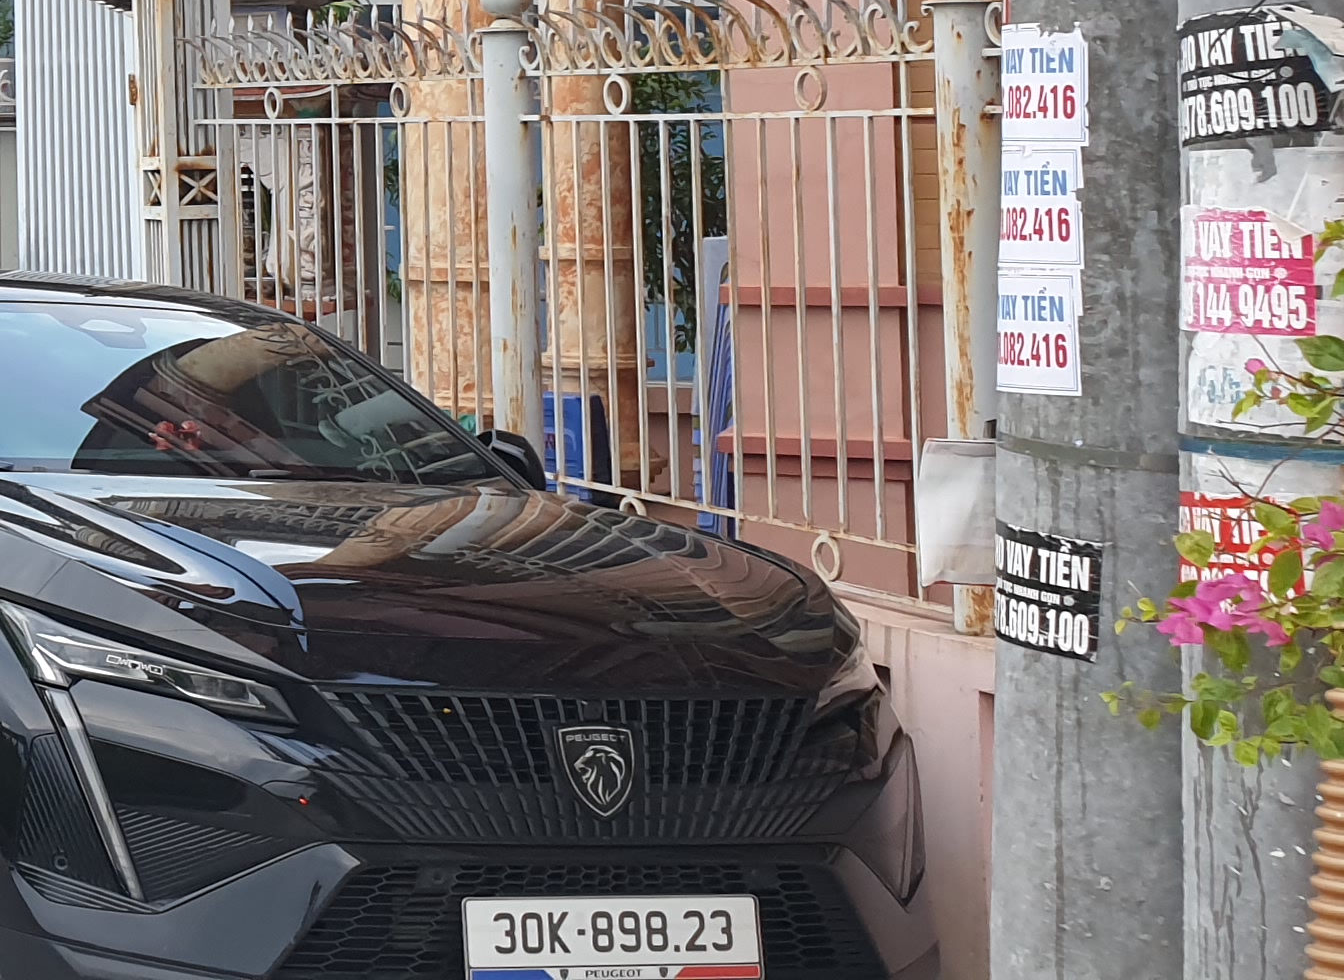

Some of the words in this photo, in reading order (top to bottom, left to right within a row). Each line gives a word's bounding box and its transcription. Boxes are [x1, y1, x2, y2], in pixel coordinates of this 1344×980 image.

[1198, 27, 1234, 68] VAY
[1002, 85, 1076, 119] .082.416
[1182, 82, 1318, 141] 978.609.100
[1198, 221, 1233, 261] VAY
[1238, 284, 1308, 330] 9495
[1006, 539, 1034, 580] VAY
[995, 592, 1090, 655] 78.609.100
[565, 732, 627, 744] PEUGEOT
[492, 909, 735, 956] 30K-898.23
[584, 968, 643, 979] PEUGEOT
